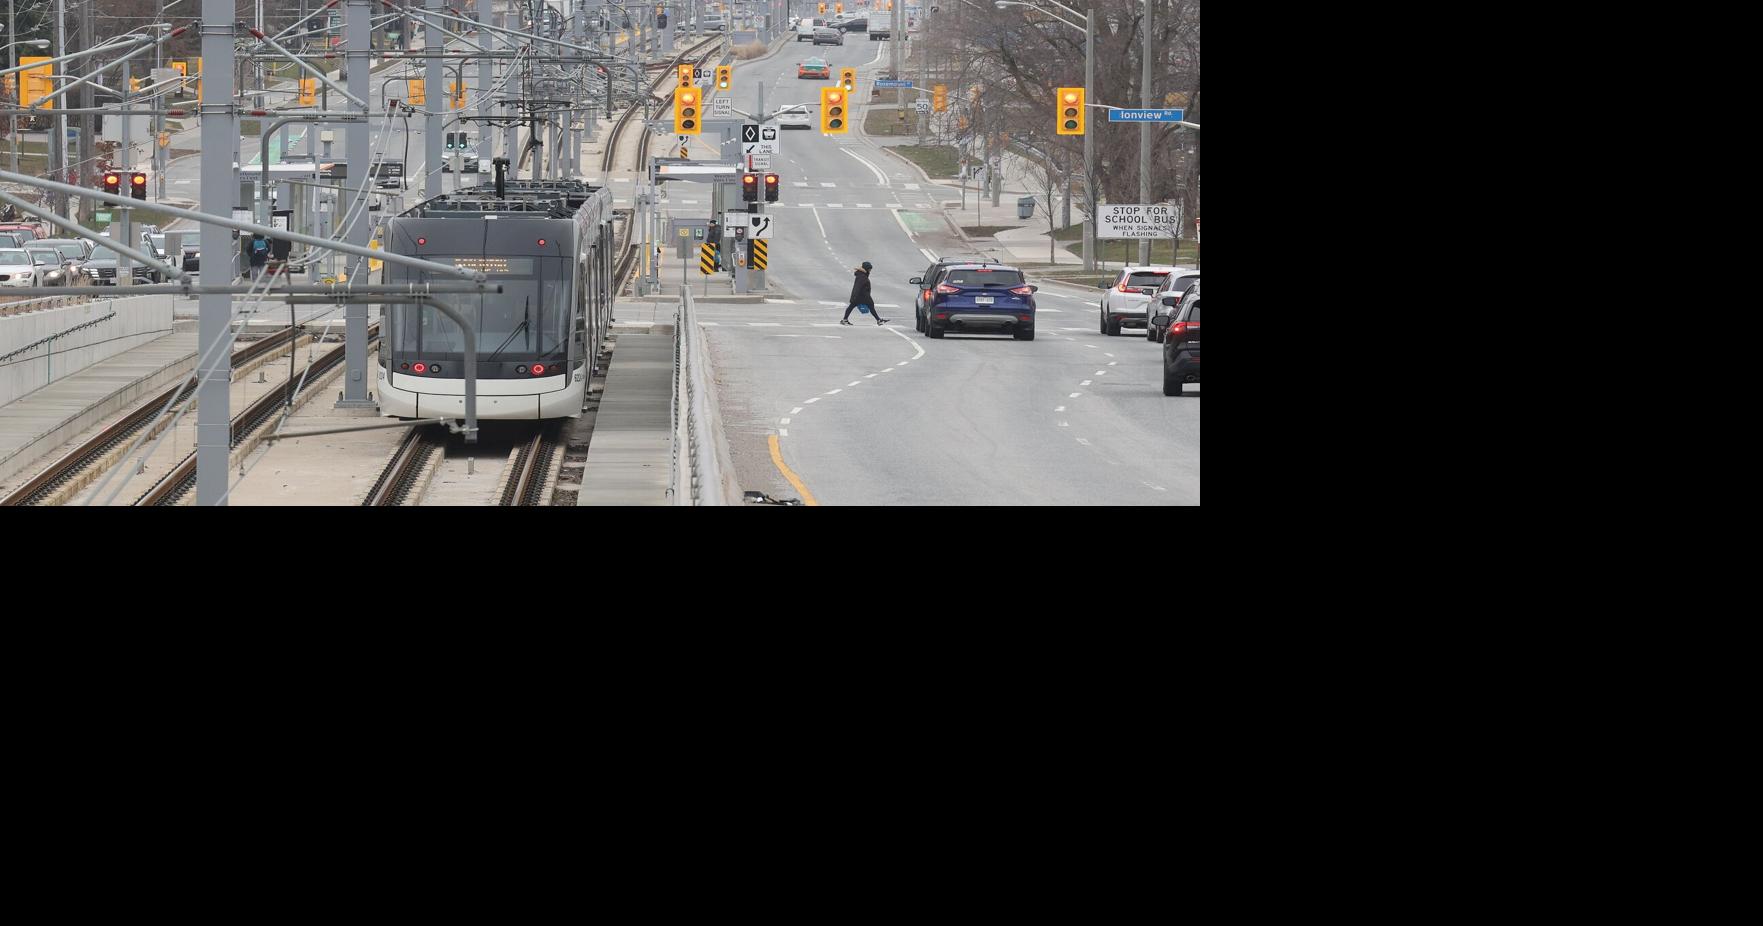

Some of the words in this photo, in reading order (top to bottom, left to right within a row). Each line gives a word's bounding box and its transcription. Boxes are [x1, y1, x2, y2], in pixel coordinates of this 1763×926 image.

[1120, 110, 1162, 119] Ionview
[1113, 206, 1140, 215] STOP
[1146, 206, 1168, 215] FOR
[1105, 215, 1147, 224] SCHOOL
[1154, 215, 1176, 224] BUS
